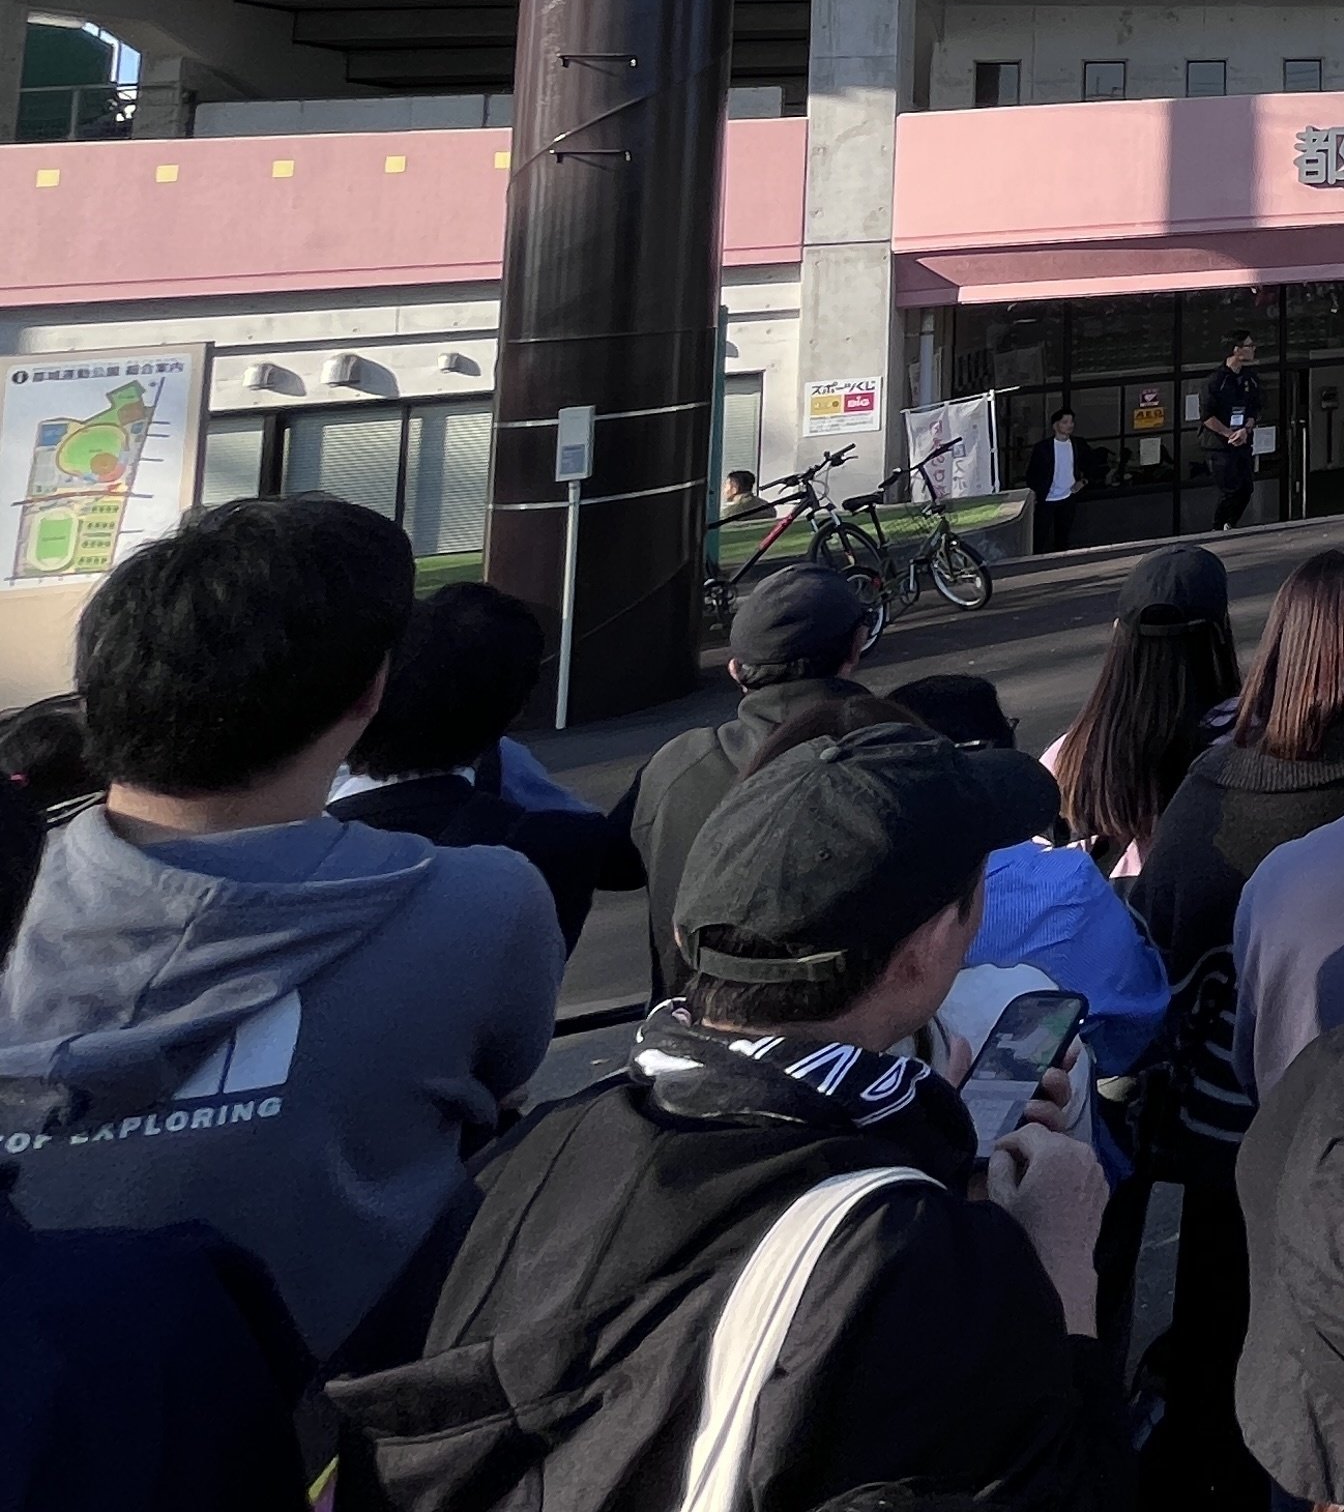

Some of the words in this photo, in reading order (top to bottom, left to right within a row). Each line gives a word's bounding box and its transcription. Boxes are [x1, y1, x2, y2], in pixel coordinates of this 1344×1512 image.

[811, 381, 876, 395] スポーツくじ
